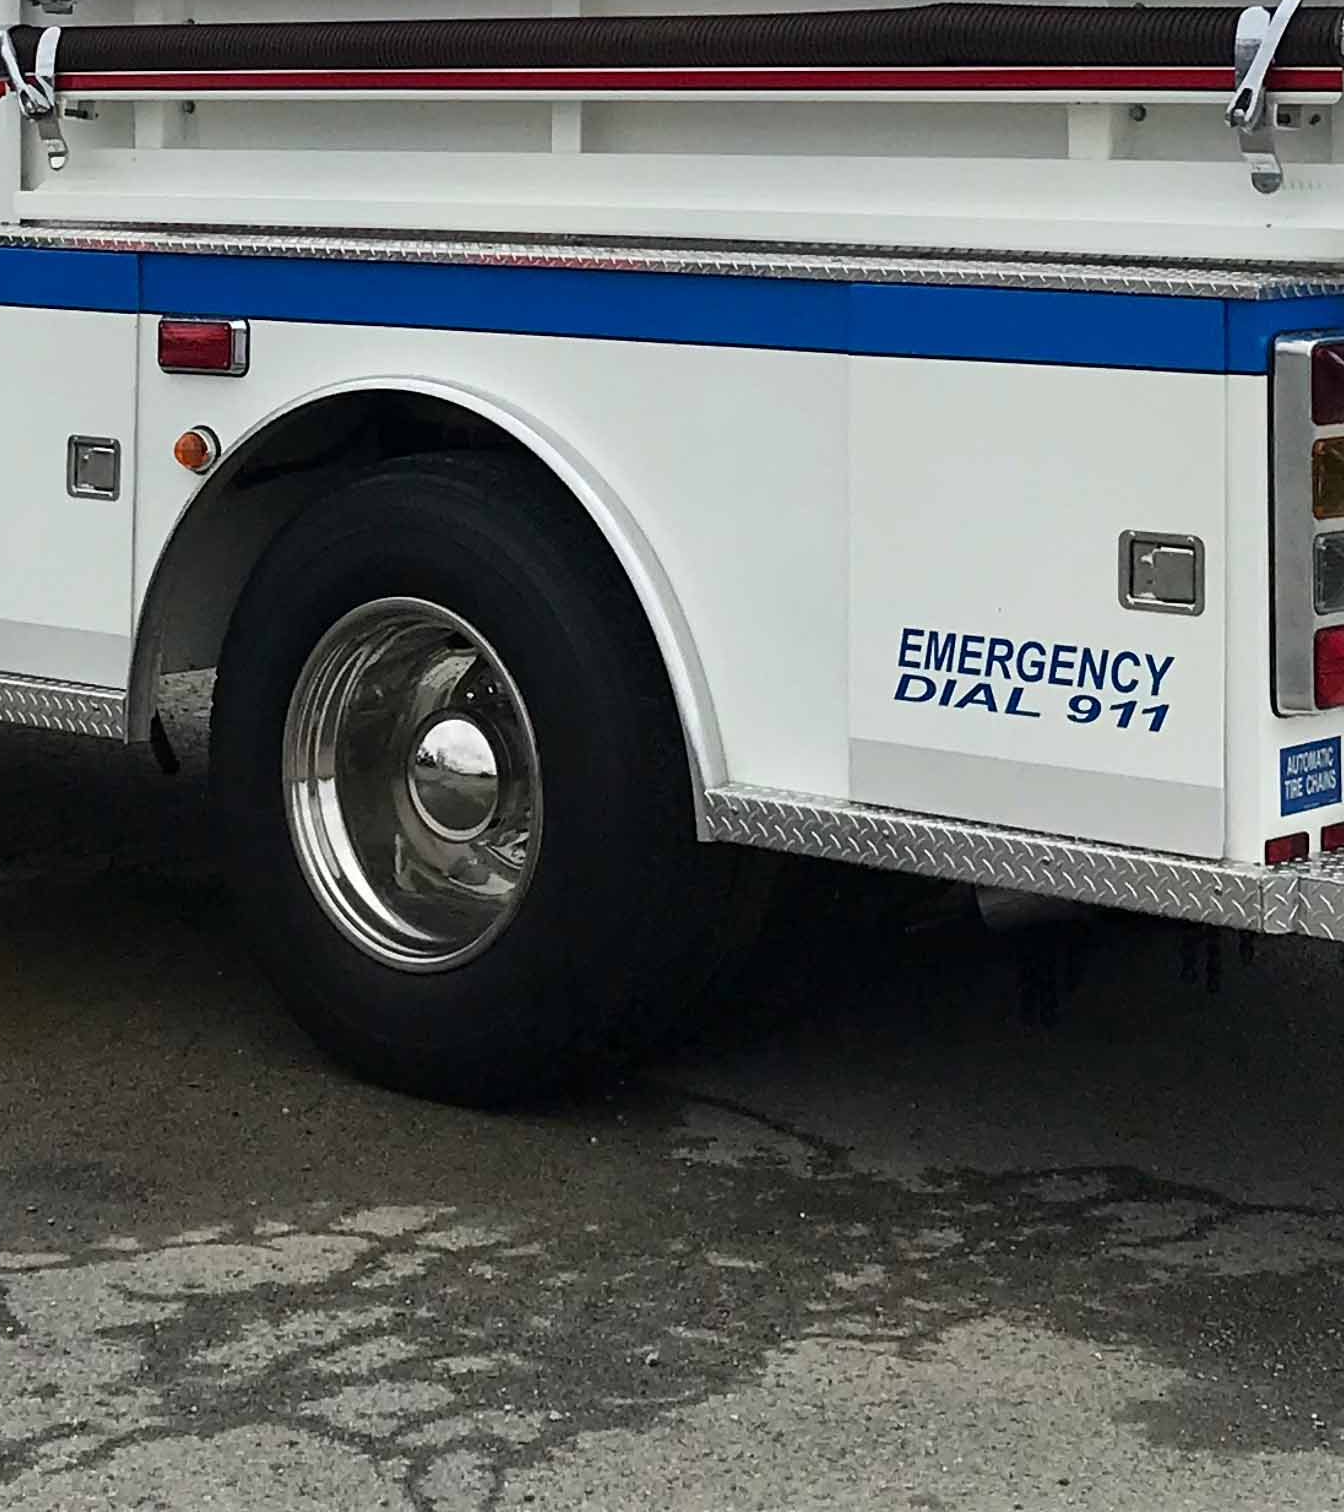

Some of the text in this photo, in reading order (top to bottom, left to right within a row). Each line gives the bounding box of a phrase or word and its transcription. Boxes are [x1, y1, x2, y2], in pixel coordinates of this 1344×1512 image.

[897, 627, 1175, 696] EMERGENCY
[894, 673, 1170, 732] DIAL 911
[1287, 746, 1334, 776] AUTOMATIC
[1284, 769, 1337, 800] TIRE CHAINS
